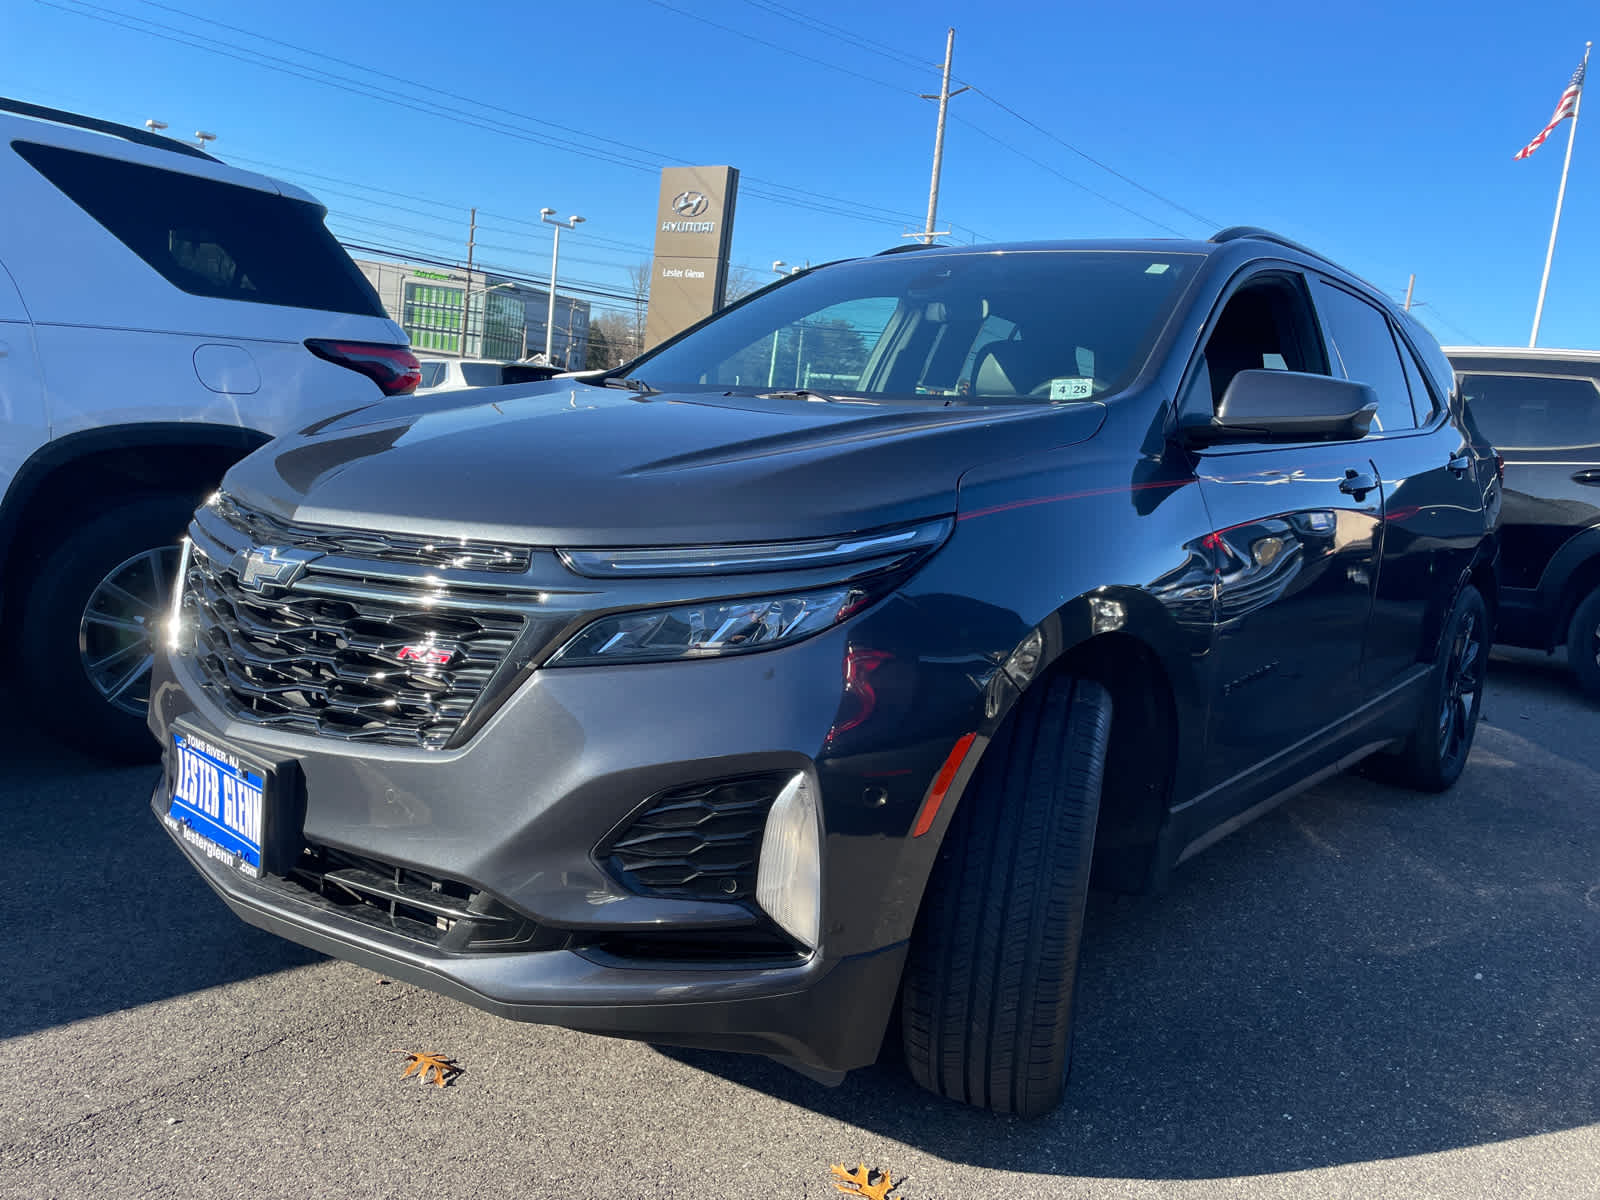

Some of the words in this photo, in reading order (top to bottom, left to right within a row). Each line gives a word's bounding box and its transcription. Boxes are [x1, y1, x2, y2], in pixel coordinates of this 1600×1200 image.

[661, 221, 715, 233] HYUNDAI
[662, 268, 683, 278] Lester
[685, 268, 705, 279] Glenn
[1059, 385, 1066, 394] 4
[1073, 385, 1088, 394] 28
[396, 645, 452, 665] RS
[186, 734, 206, 752] TOMS
[206, 744, 228, 764] RIVER,
[229, 755, 240, 769] NJ
[176, 747, 220, 819] LESTER
[223, 774, 263, 847] GLENN
